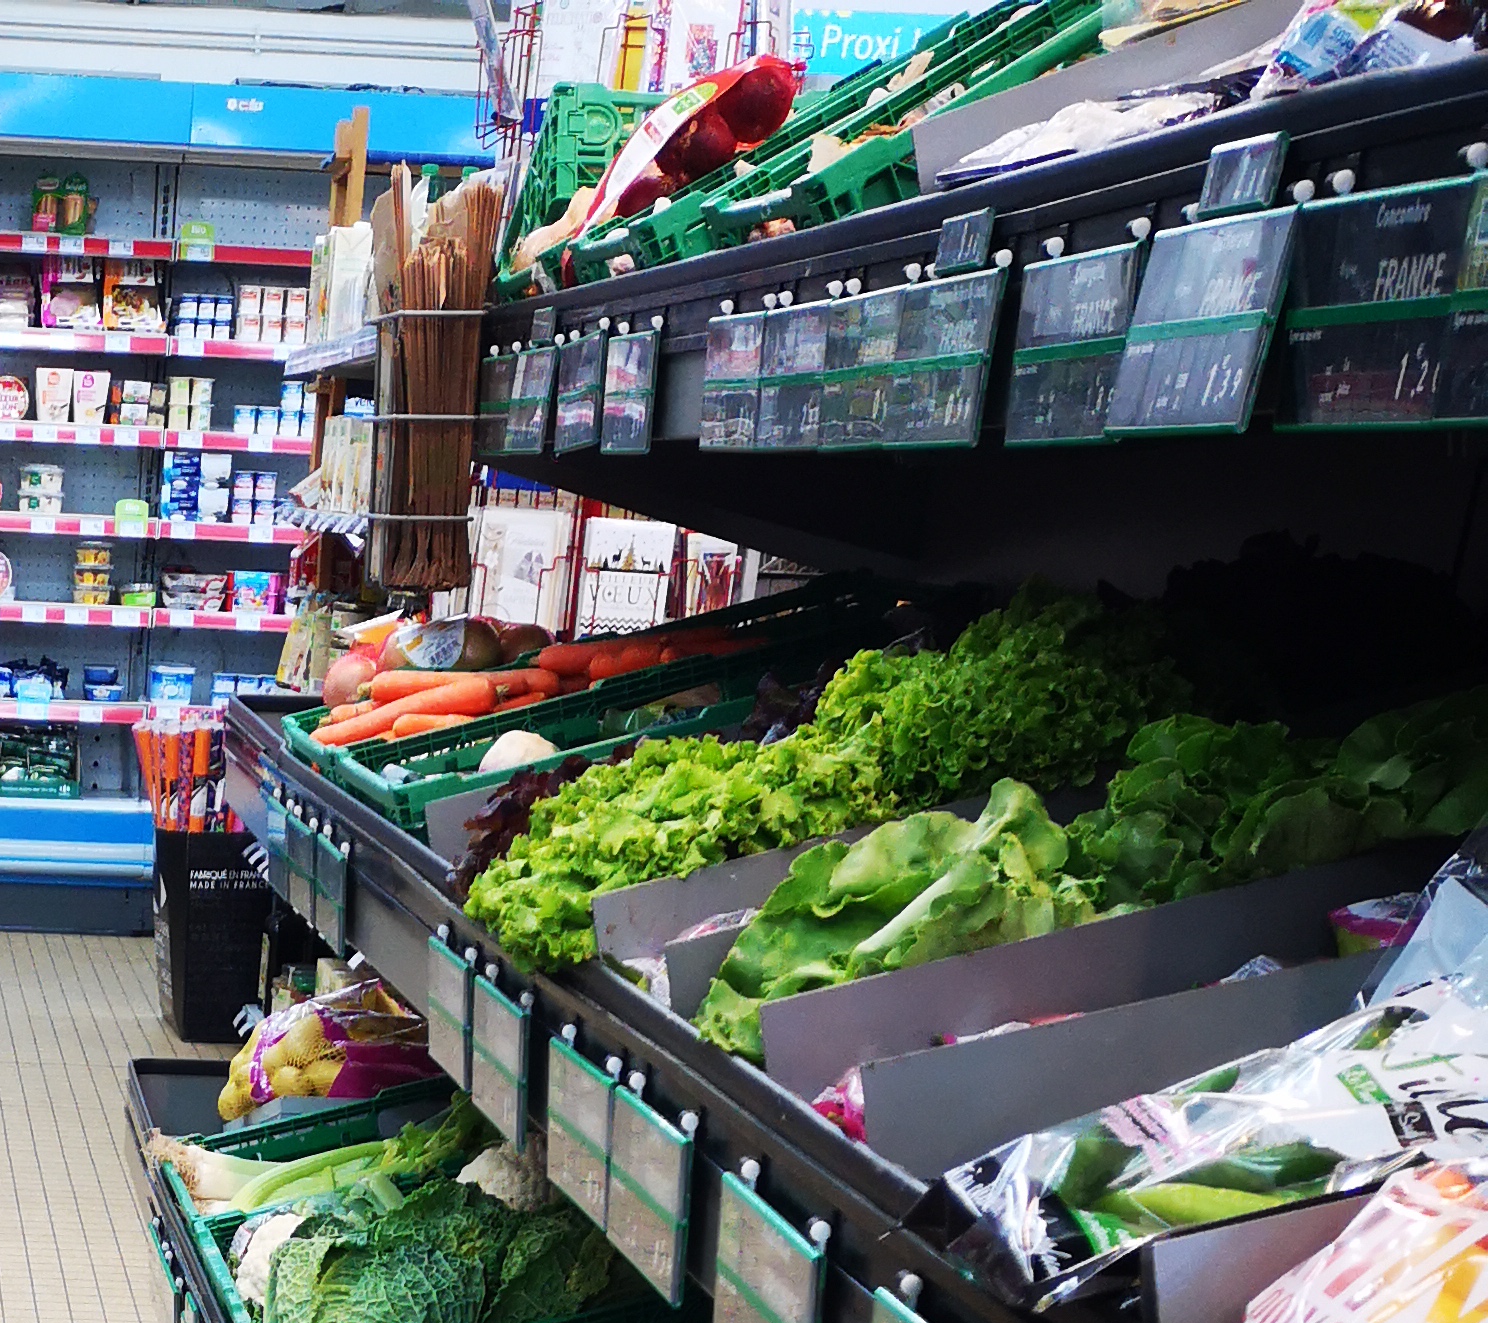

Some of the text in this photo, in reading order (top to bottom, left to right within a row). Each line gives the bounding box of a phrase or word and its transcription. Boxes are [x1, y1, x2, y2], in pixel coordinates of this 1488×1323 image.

[820, 25, 904, 61] Proxi
[1373, 252, 1446, 301] FRANCE
[189, 880, 216, 891] MADE
